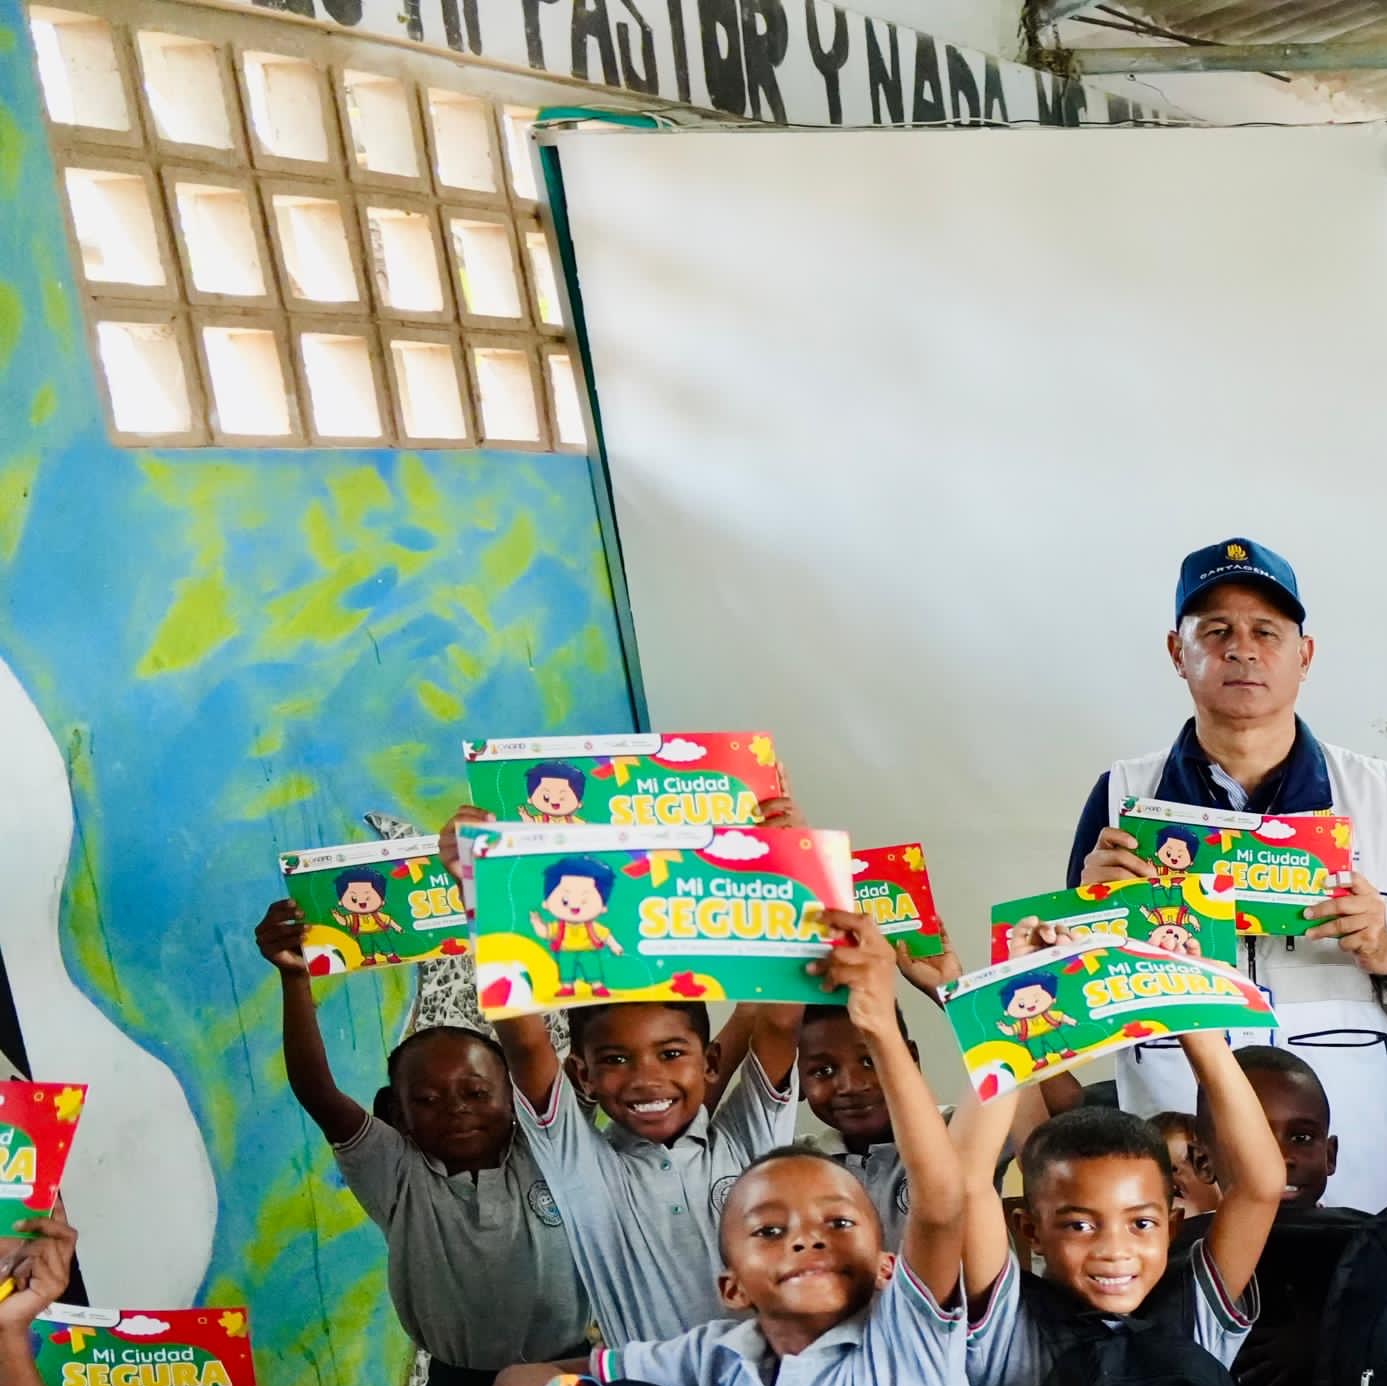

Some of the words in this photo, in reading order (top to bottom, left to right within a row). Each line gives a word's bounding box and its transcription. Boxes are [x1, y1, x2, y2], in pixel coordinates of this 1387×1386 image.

[805, 2, 850, 125] Y
[864, 17, 1009, 128] NADA
[636, 778, 659, 794] Mi
[663, 776, 730, 794] Ciudad
[608, 793, 764, 824] SEGURA
[1236, 849, 1253, 863] Mi
[1256, 849, 1310, 867] Ciudad
[429, 875, 450, 889] Mi
[676, 878, 702, 896] Mi
[710, 878, 794, 900] Ciudad
[638, 898, 833, 942] SEGURA
[1108, 963, 1131, 976] Mi
[1135, 960, 1203, 976] Ciudad
[1083, 972, 1244, 1009] SEGURA
[92, 1347, 116, 1364] Mi
[120, 1346, 195, 1364] Ciudad
